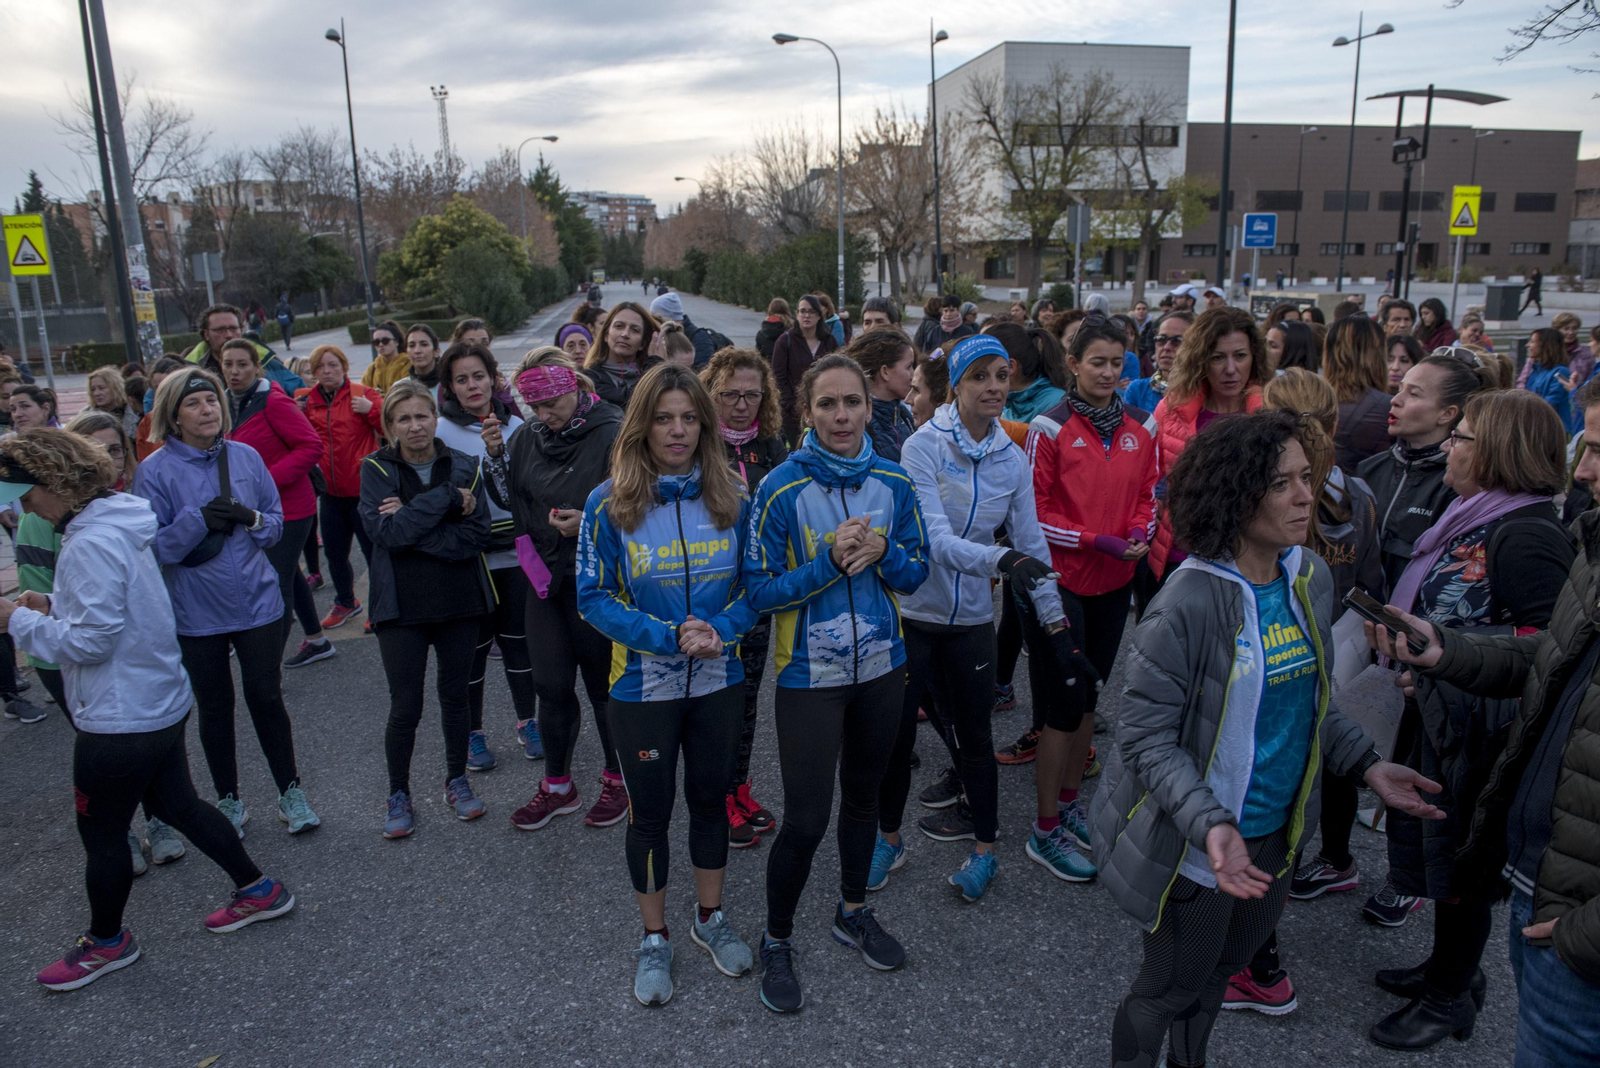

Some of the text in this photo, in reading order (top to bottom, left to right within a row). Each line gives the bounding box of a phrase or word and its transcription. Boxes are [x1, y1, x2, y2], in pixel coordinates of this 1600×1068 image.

[4, 221, 43, 229] ATENCIÓN
[748, 507, 761, 561] deportes
[657, 538, 730, 558] olimpo
[657, 558, 709, 571] deportes
[660, 571, 731, 587] TRAIL & RUNNING
[1266, 645, 1308, 666] eportes
[1268, 672, 1291, 687] TRAIL
[1294, 669, 1299, 678] &
